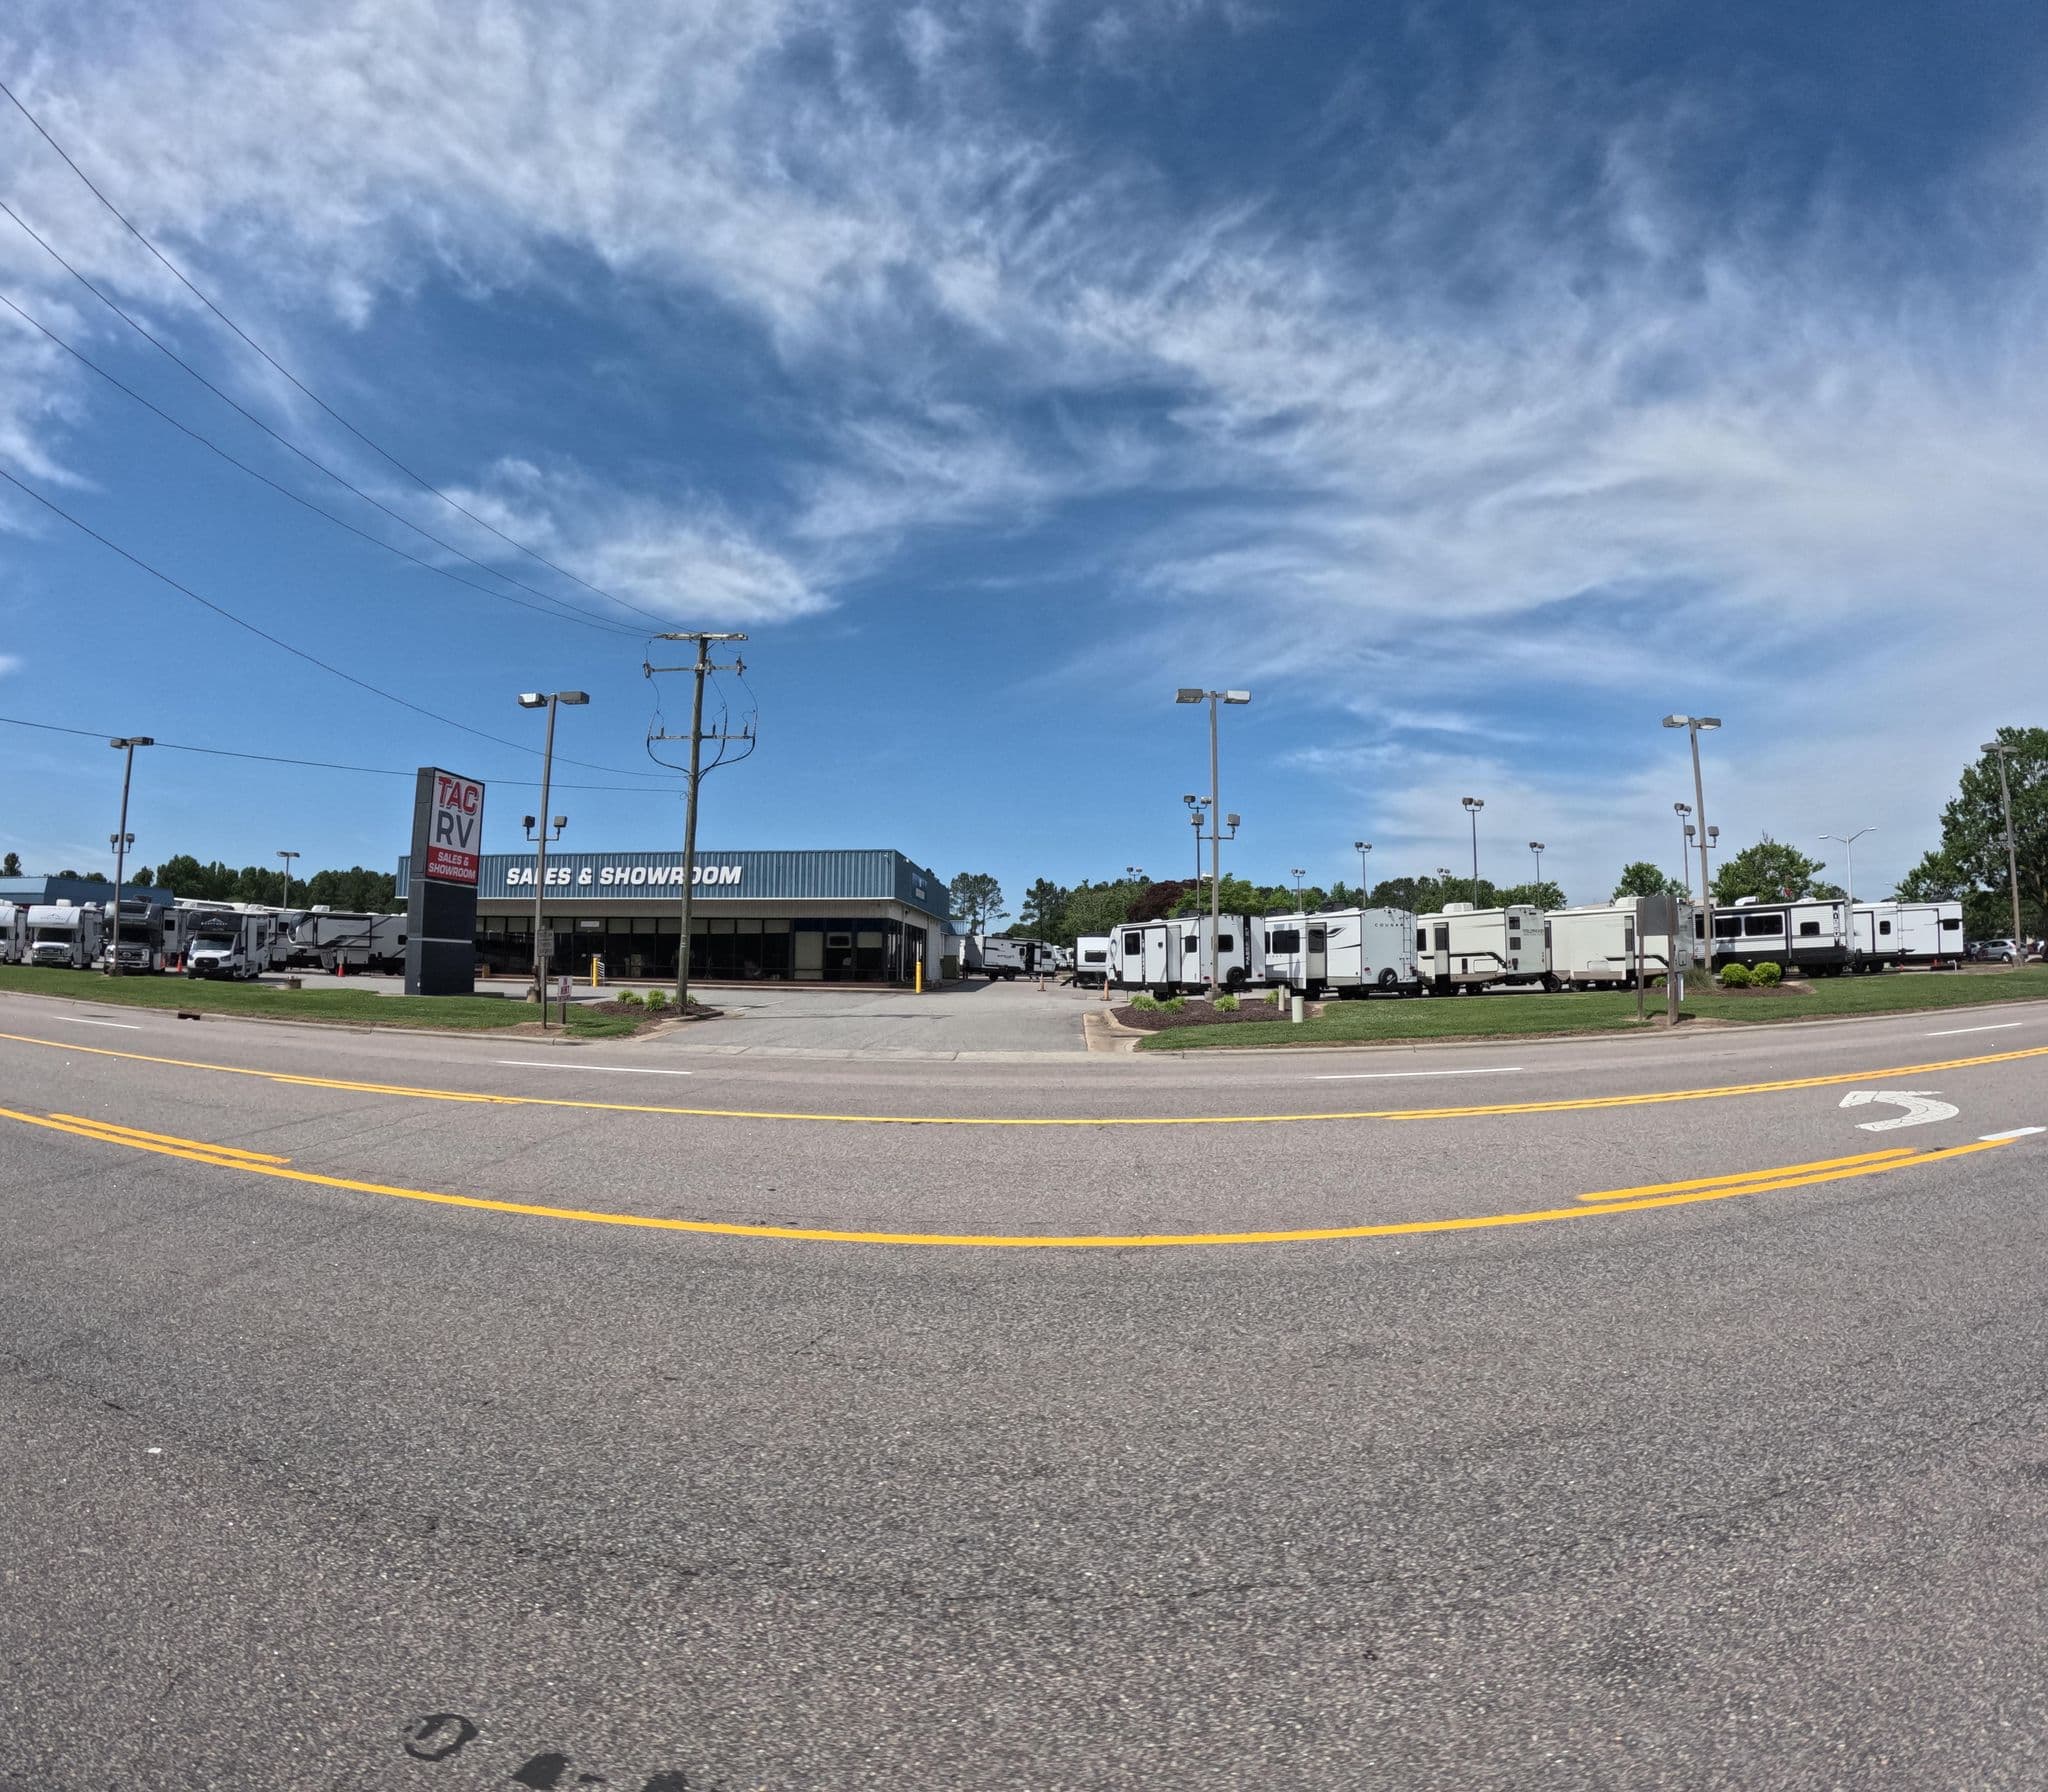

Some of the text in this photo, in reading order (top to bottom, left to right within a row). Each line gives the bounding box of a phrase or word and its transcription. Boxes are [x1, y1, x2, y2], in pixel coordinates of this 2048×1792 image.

[438, 776, 479, 816] TAC
[436, 810, 474, 848] RV
[438, 852, 469, 866] SALES &
[428, 862, 476, 879] SHOWROOM
[578, 867, 593, 885] &
